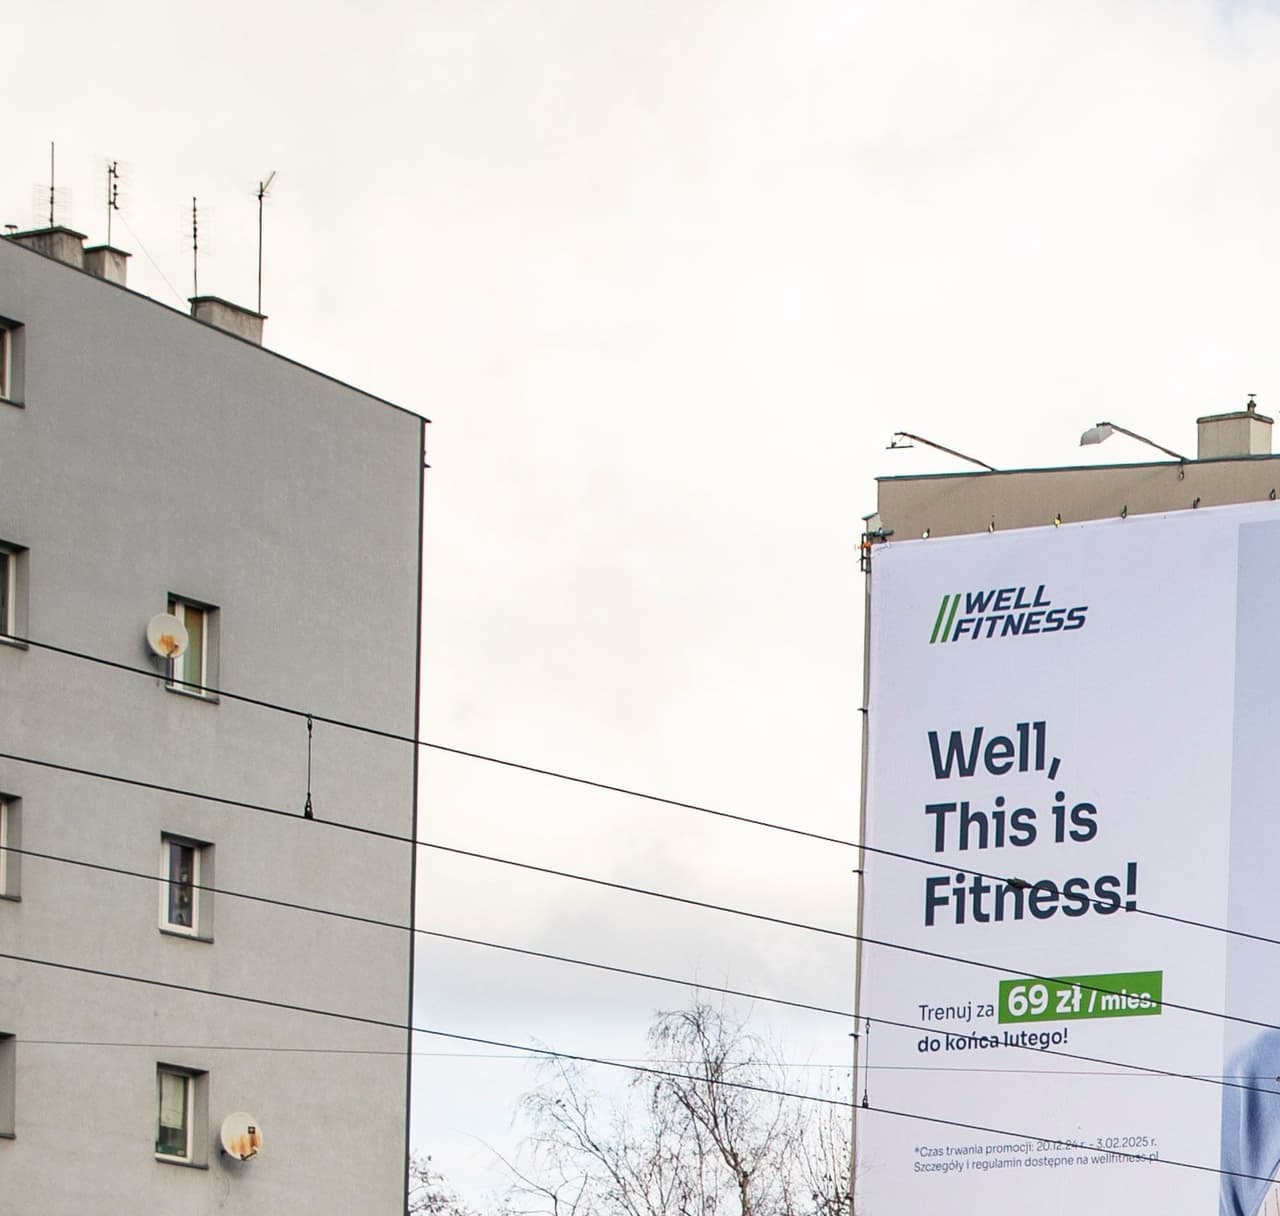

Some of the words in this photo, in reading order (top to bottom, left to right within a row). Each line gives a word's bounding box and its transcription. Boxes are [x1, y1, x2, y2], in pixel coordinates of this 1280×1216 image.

[965, 584, 1051, 615] WELL
[951, 606, 1088, 643] FITNESS
[927, 720, 1062, 780] Well,
[924, 796, 1038, 852] This
[1051, 790, 1098, 843] is
[924, 862, 1138, 926] Fitness!
[919, 1001, 972, 1022] Trenuj
[977, 1003, 995, 1018] za
[1007, 984, 1049, 1017] 69
[1055, 982, 1081, 1013] zł
[1088, 990, 1097, 1013] /
[1101, 989, 1157, 1011] mies.
[917, 1036, 941, 1053] do
[946, 1030, 999, 1051] końca
[1004, 1027, 1068, 1052] lutego!
[914, 1159, 964, 1174] Szczegóły
[972, 1158, 1022, 1172] regulamin
[1024, 1156, 1074, 1168] dostępne
[1076, 1155, 1089, 1165] na
[946, 1144, 983, 1156] trwania
[985, 1141, 1034, 1156] promocji:
